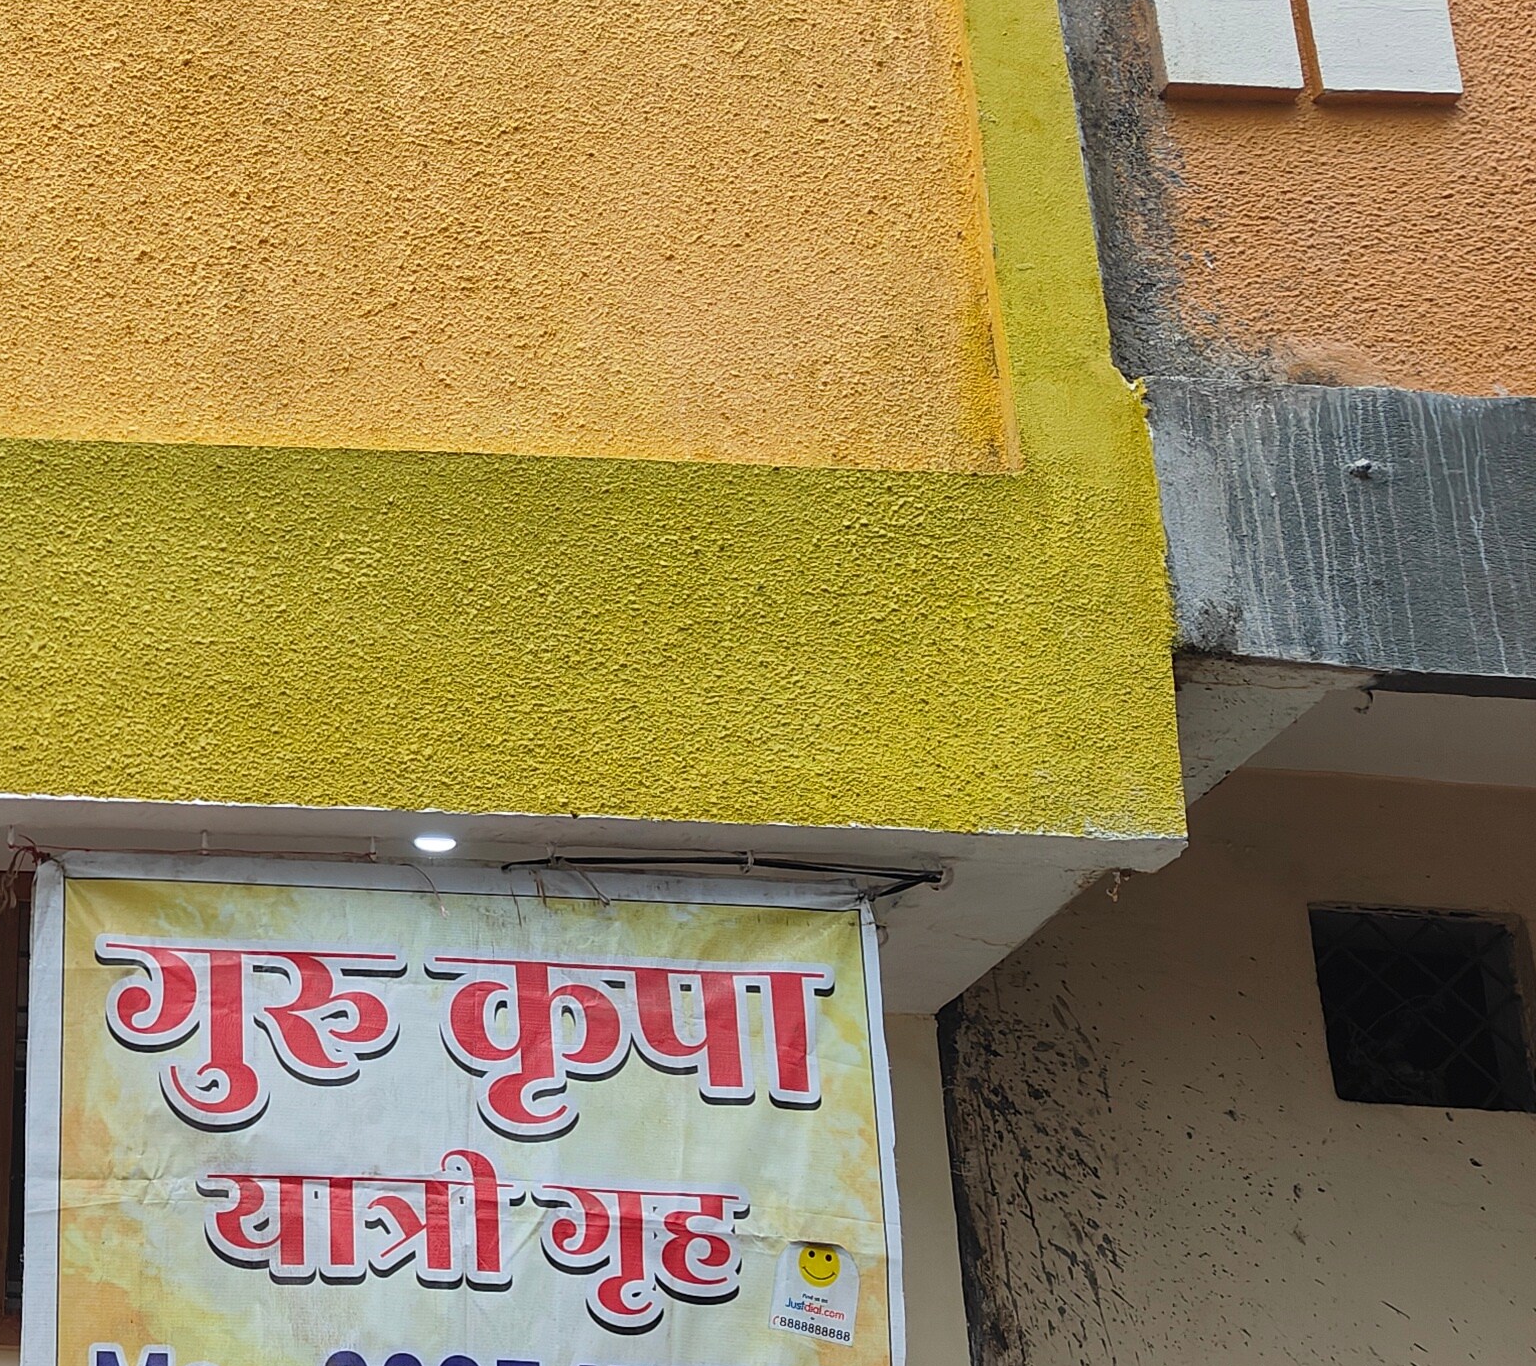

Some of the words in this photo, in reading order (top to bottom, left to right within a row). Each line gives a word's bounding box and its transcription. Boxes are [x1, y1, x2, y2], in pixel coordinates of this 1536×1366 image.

[424, 947, 834, 1142] कृपा
[196, 1149, 525, 1291] यात्री
[532, 1180, 751, 1335] गृह
[779, 1316, 851, 1341] 8888888888
